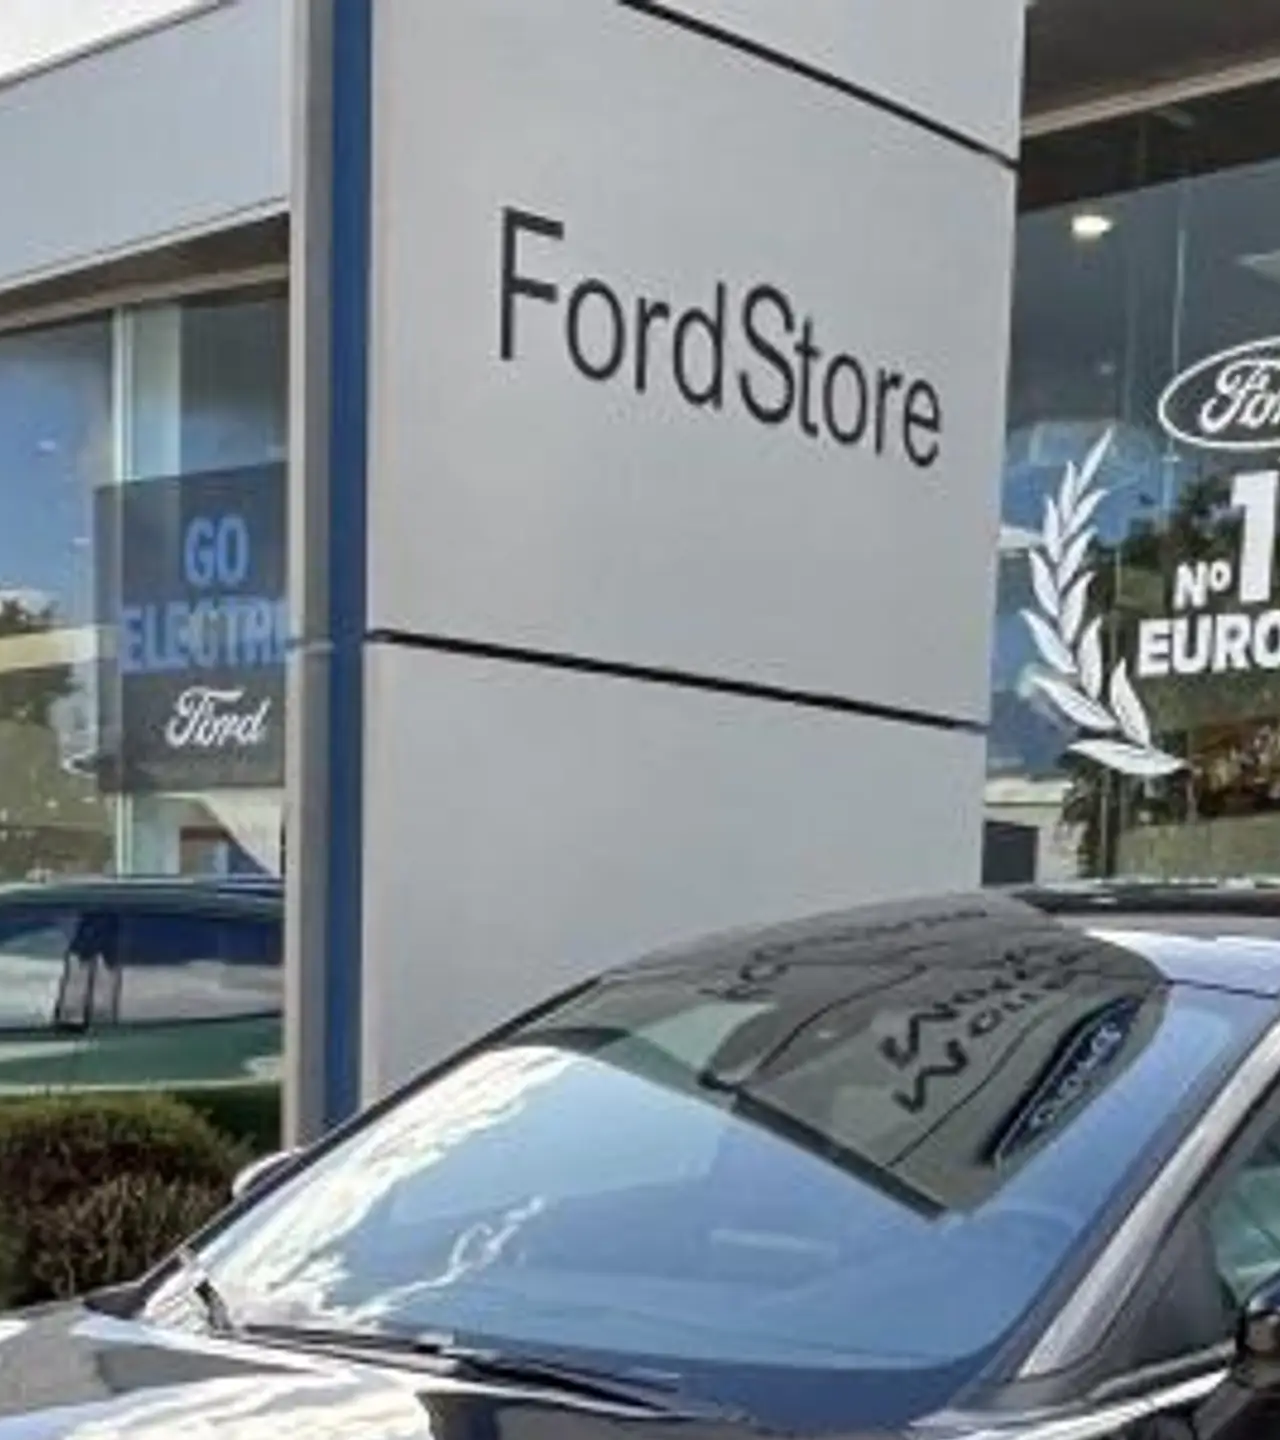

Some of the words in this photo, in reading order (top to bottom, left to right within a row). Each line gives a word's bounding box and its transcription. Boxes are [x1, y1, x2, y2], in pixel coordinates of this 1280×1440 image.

[500, 206, 941, 468] FordStore
[184, 512, 250, 588] GO
[165, 685, 271, 747] Ford
